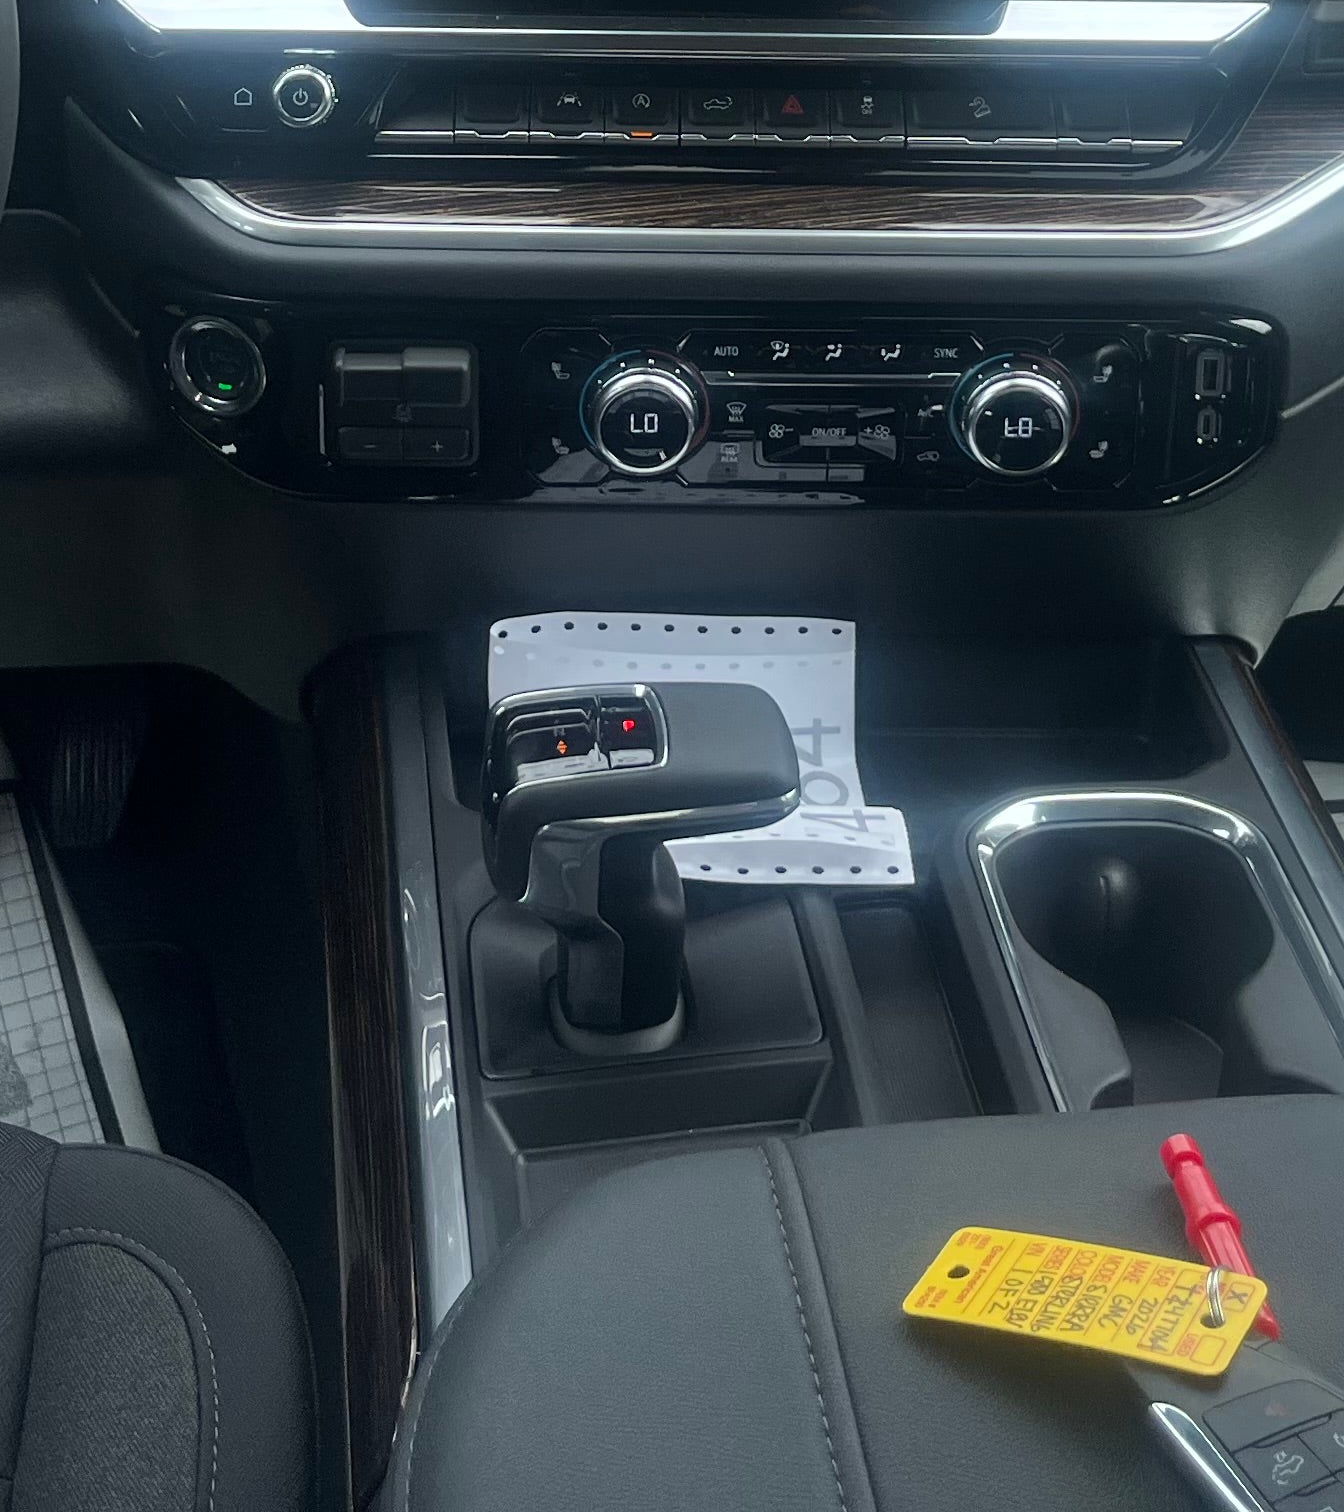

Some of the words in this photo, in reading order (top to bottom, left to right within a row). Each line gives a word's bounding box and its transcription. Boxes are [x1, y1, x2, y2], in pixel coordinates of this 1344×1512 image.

[714, 346, 739, 358] AUTO
[934, 347, 959, 358] SYNC
[630, 414, 658, 433] LO
[812, 427, 848, 438] ON/OFF
[979, 1244, 1004, 1267] Great
[1121, 1259, 1150, 1284] MAKE
[1148, 1264, 1176, 1287] YEAR
[952, 1267, 987, 1304] American
[1096, 1293, 1135, 1330] GMC
[1123, 1296, 1160, 1336] 2026
